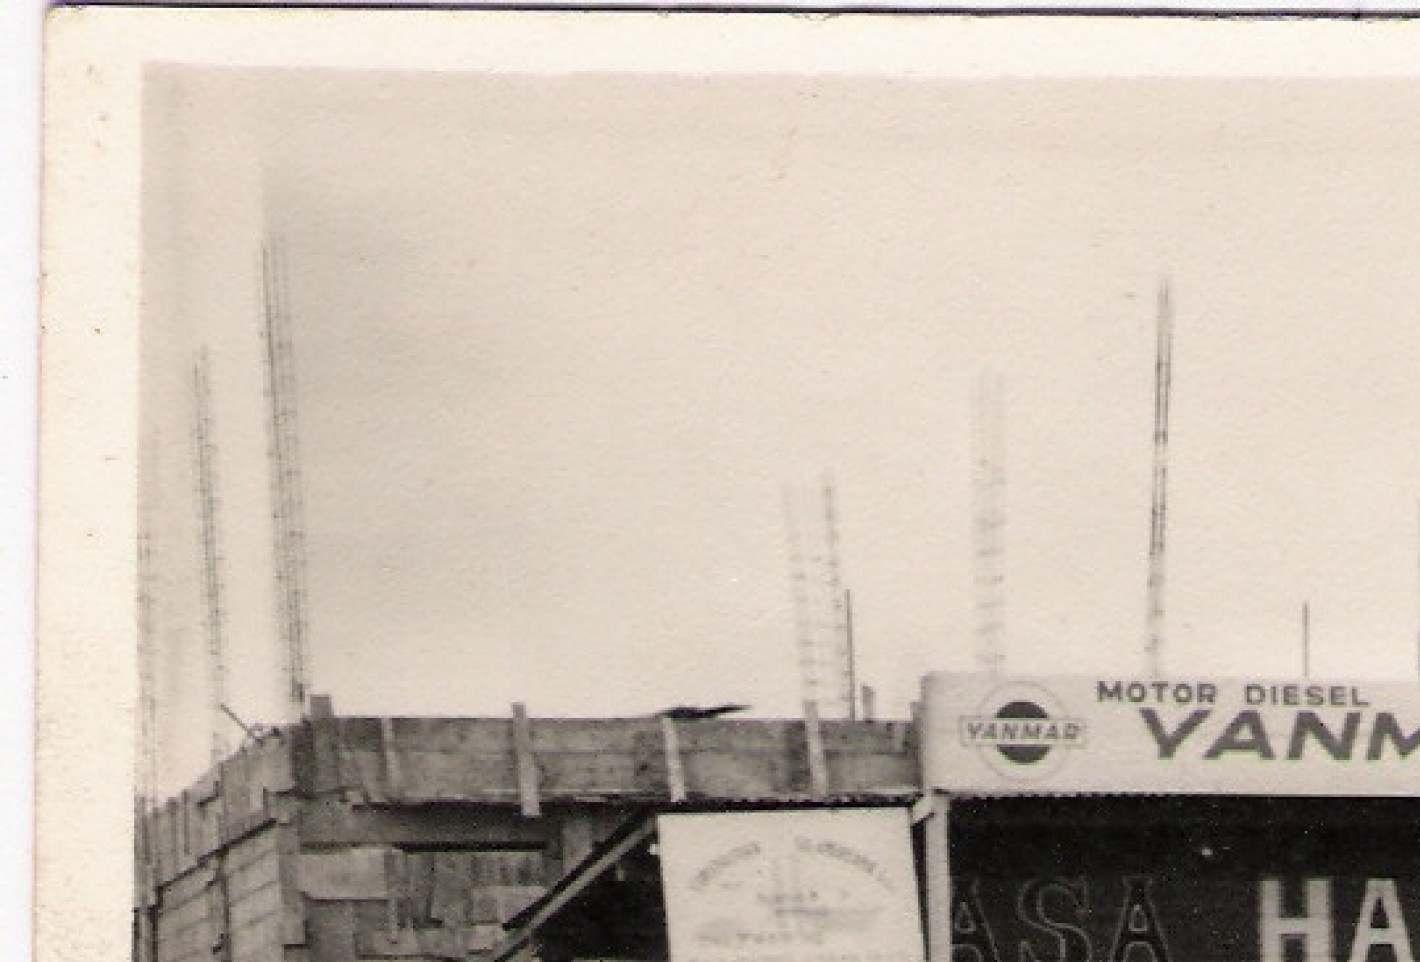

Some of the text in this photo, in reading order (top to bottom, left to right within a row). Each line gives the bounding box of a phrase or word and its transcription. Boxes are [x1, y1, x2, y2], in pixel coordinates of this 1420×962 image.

[1097, 680, 1370, 706] MOTOR DIESEL
[967, 722, 1081, 741] YANMAR
